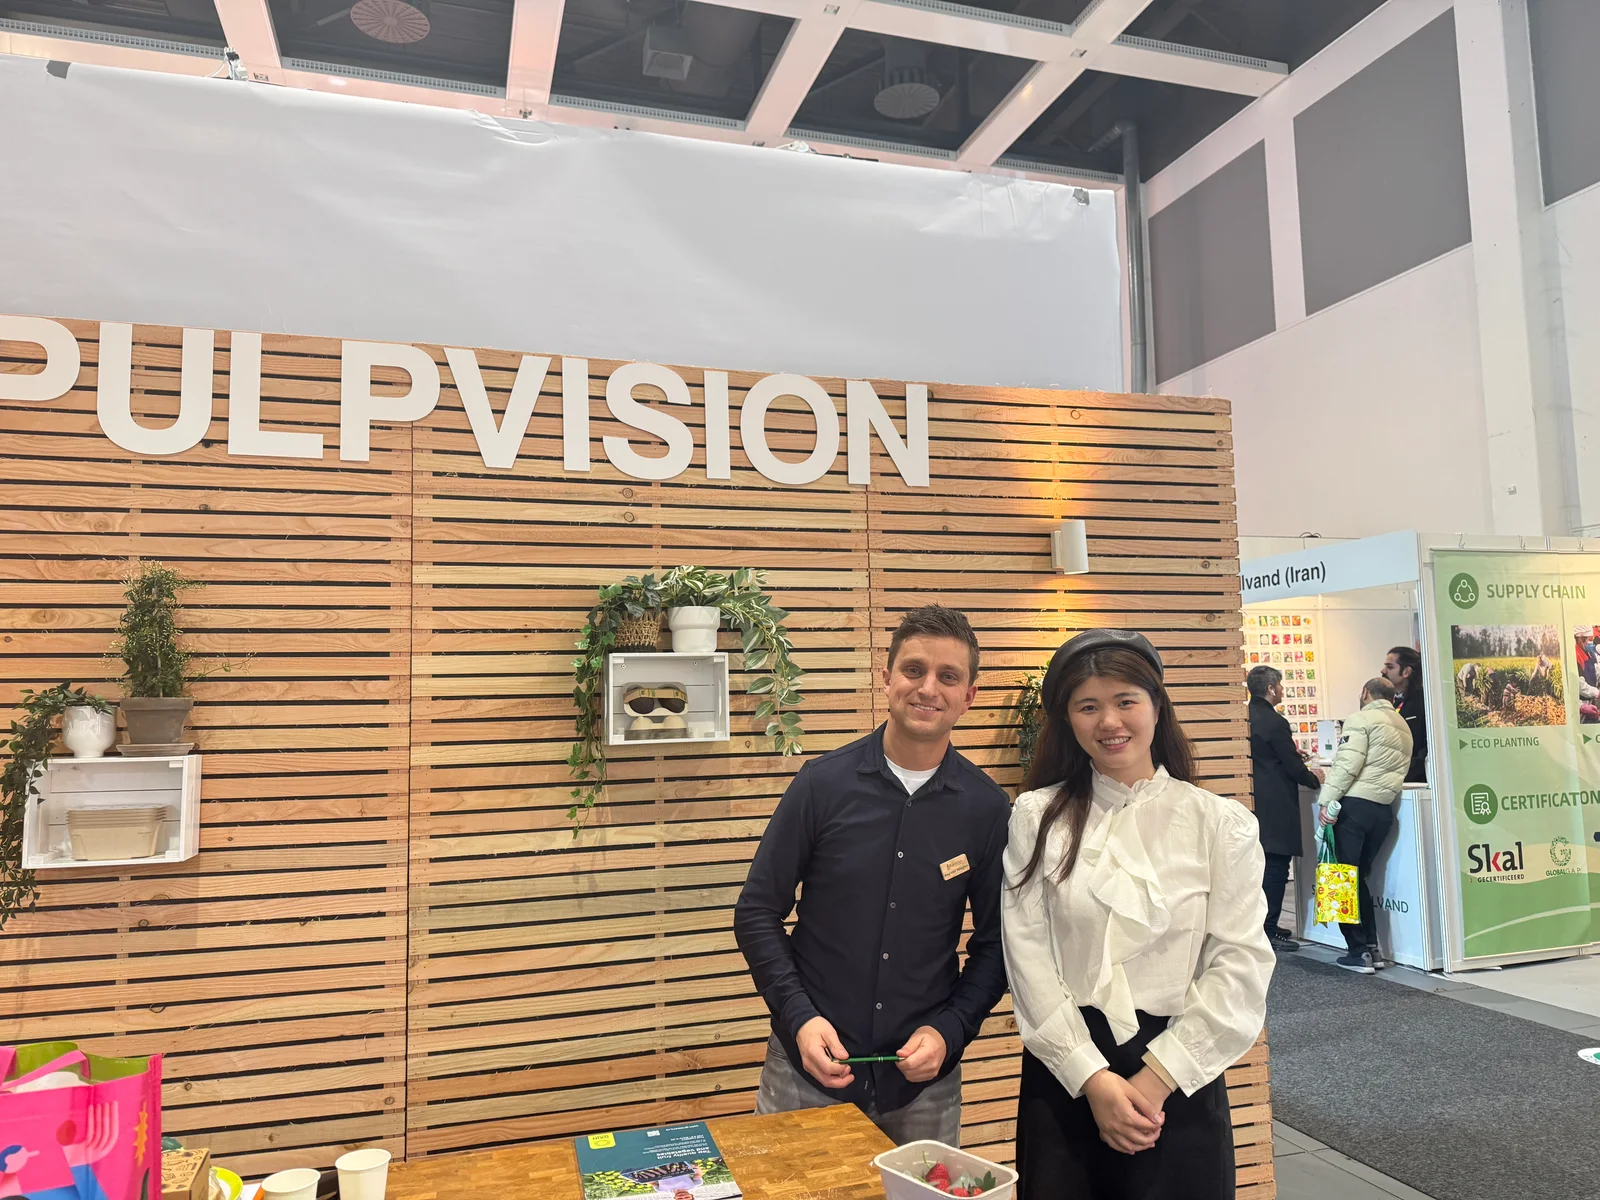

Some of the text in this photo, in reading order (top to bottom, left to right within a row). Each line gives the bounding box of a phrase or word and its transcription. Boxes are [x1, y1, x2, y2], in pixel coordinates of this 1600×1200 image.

[0, 315, 930, 487] PULPVISION
[1285, 561, 1326, 588] (Iran)
[1486, 584, 1586, 599] SUPPLY CHAIN
[1471, 737, 1540, 749] ECO PLANTING
[1467, 841, 1524, 874] Skal
[1477, 873, 1525, 883] GECERTIFICEERD
